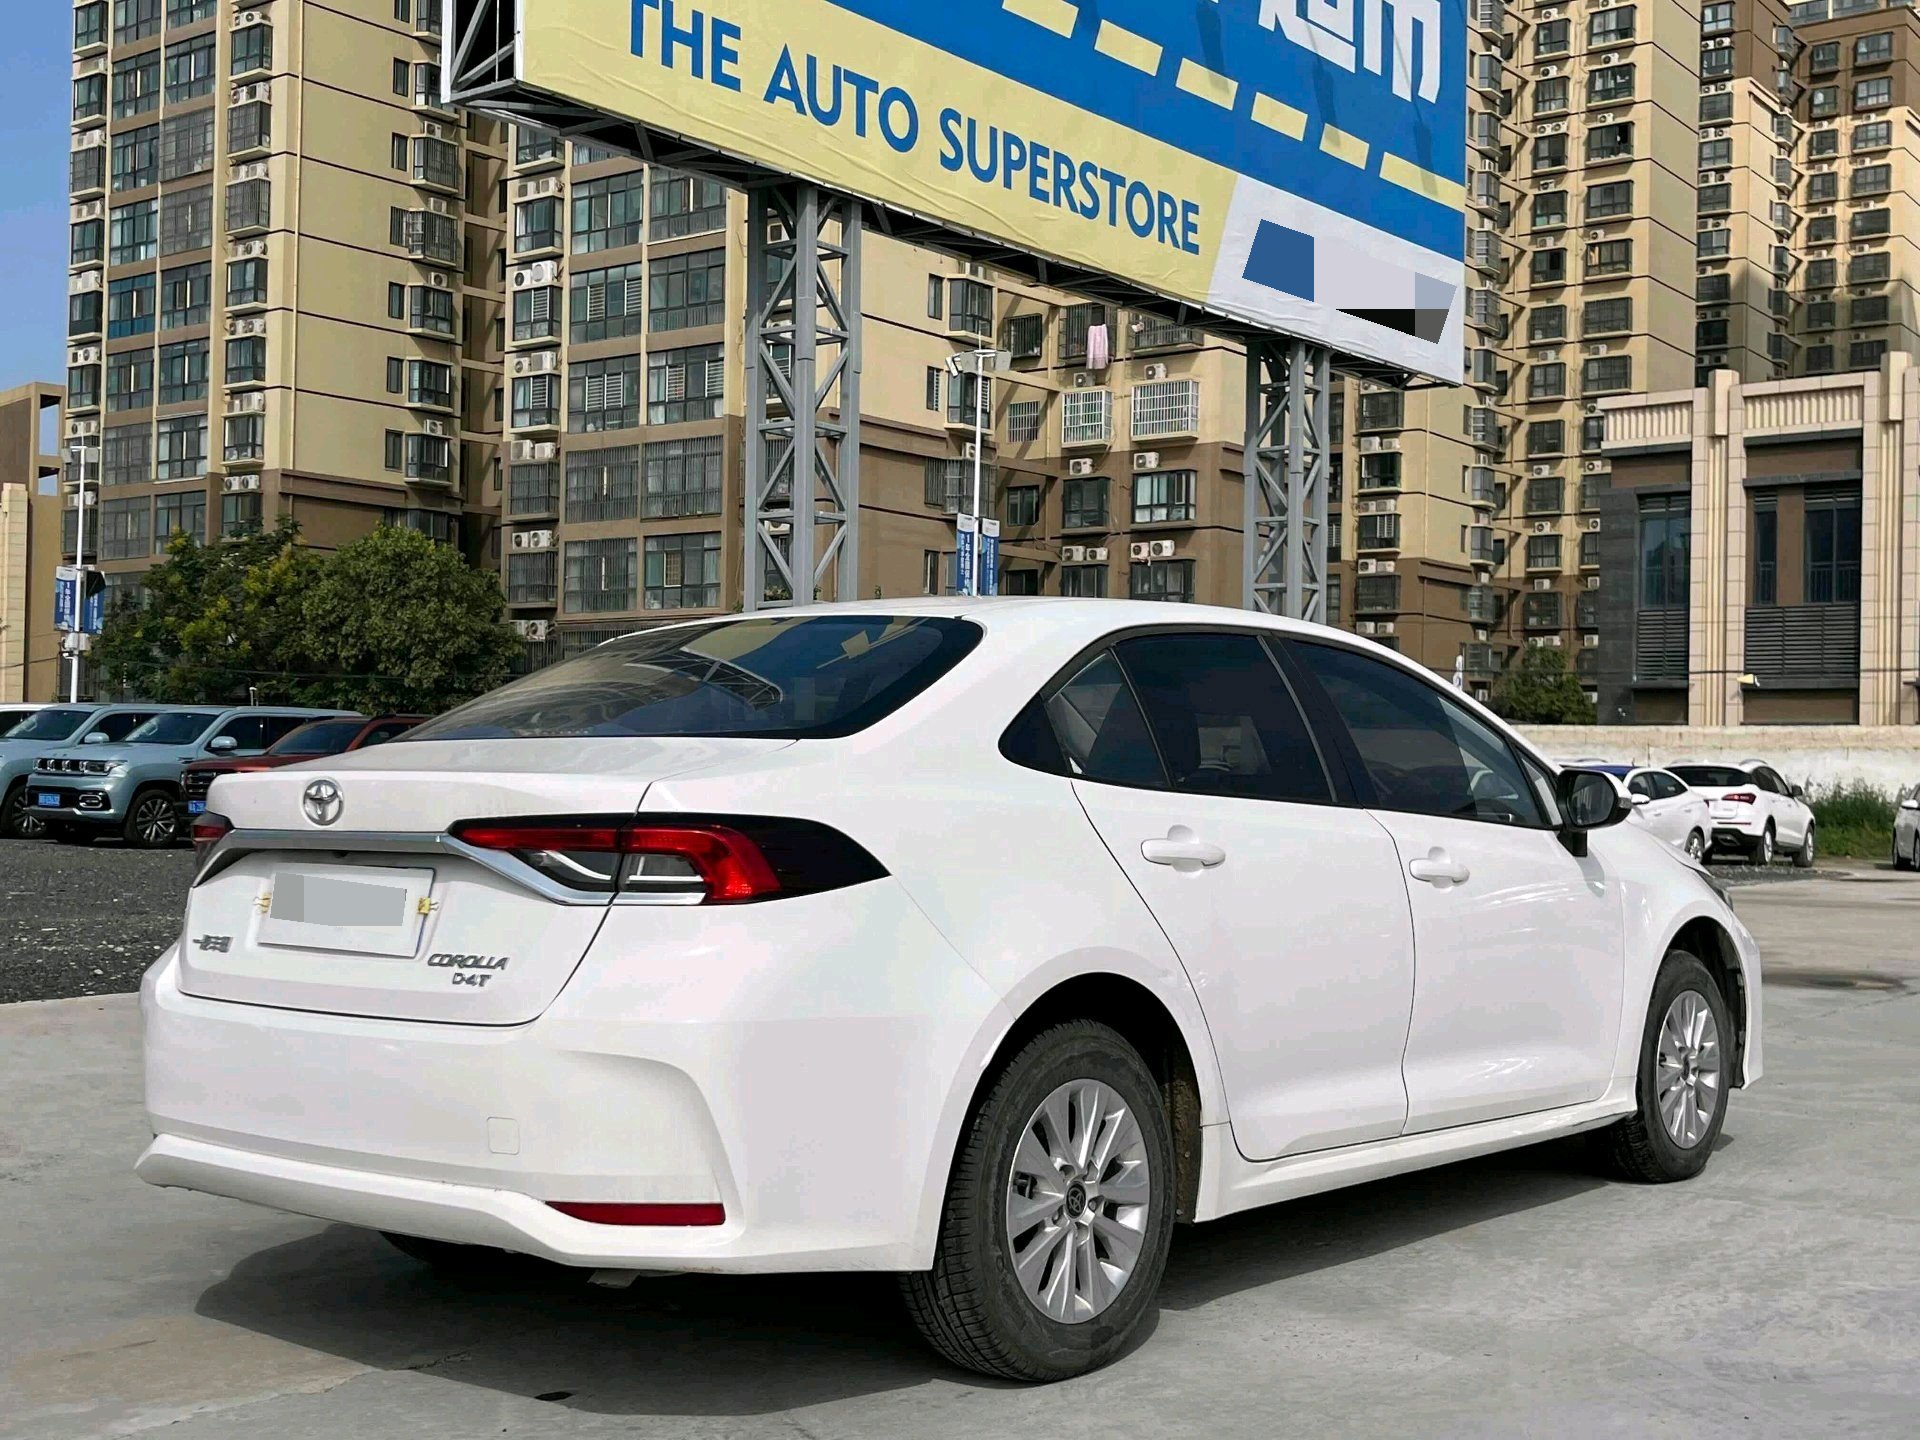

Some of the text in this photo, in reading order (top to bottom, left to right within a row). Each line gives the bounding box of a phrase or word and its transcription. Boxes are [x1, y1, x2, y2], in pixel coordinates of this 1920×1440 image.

[630, 0, 1200, 256] THE AUTO SUPERSTORE
[427, 953, 510, 970] COROLLA
